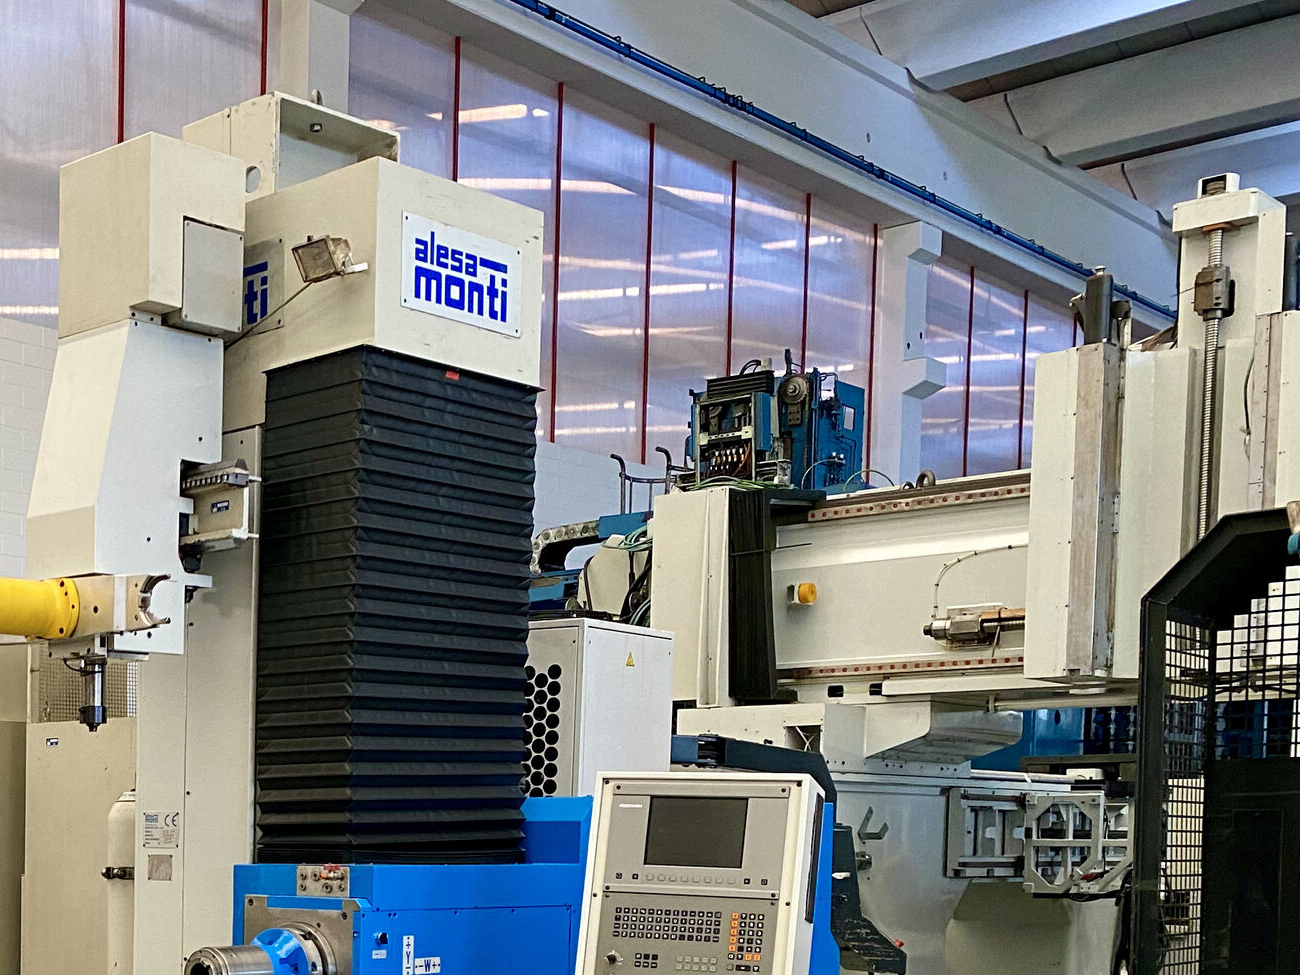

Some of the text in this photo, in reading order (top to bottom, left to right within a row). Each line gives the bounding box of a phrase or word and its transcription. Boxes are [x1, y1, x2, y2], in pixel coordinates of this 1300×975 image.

[414, 231, 478, 278] alesa
[244, 275, 269, 325] ti
[414, 265, 508, 323] monti
